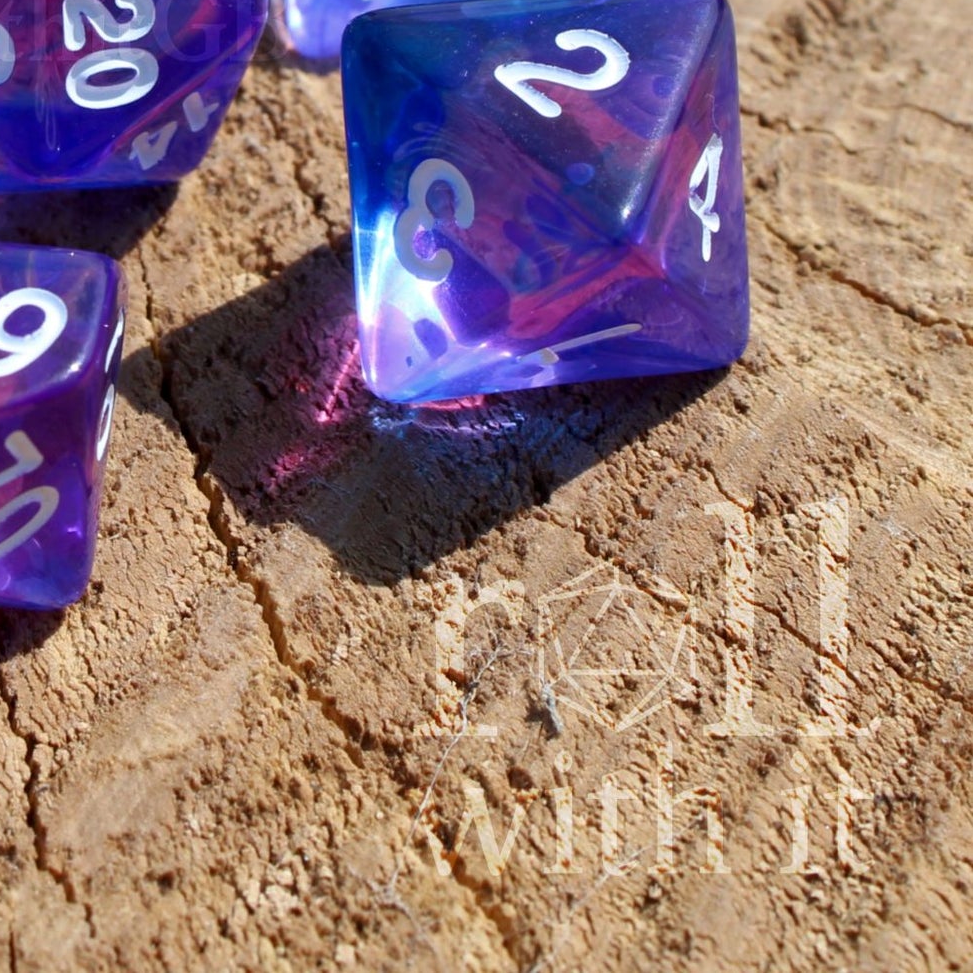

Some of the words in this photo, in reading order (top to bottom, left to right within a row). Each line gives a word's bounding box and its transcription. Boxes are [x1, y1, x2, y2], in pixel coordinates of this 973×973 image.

[494, 29, 630, 118] 2
[393, 158, 475, 284] 3
[689, 132, 723, 262] 4
